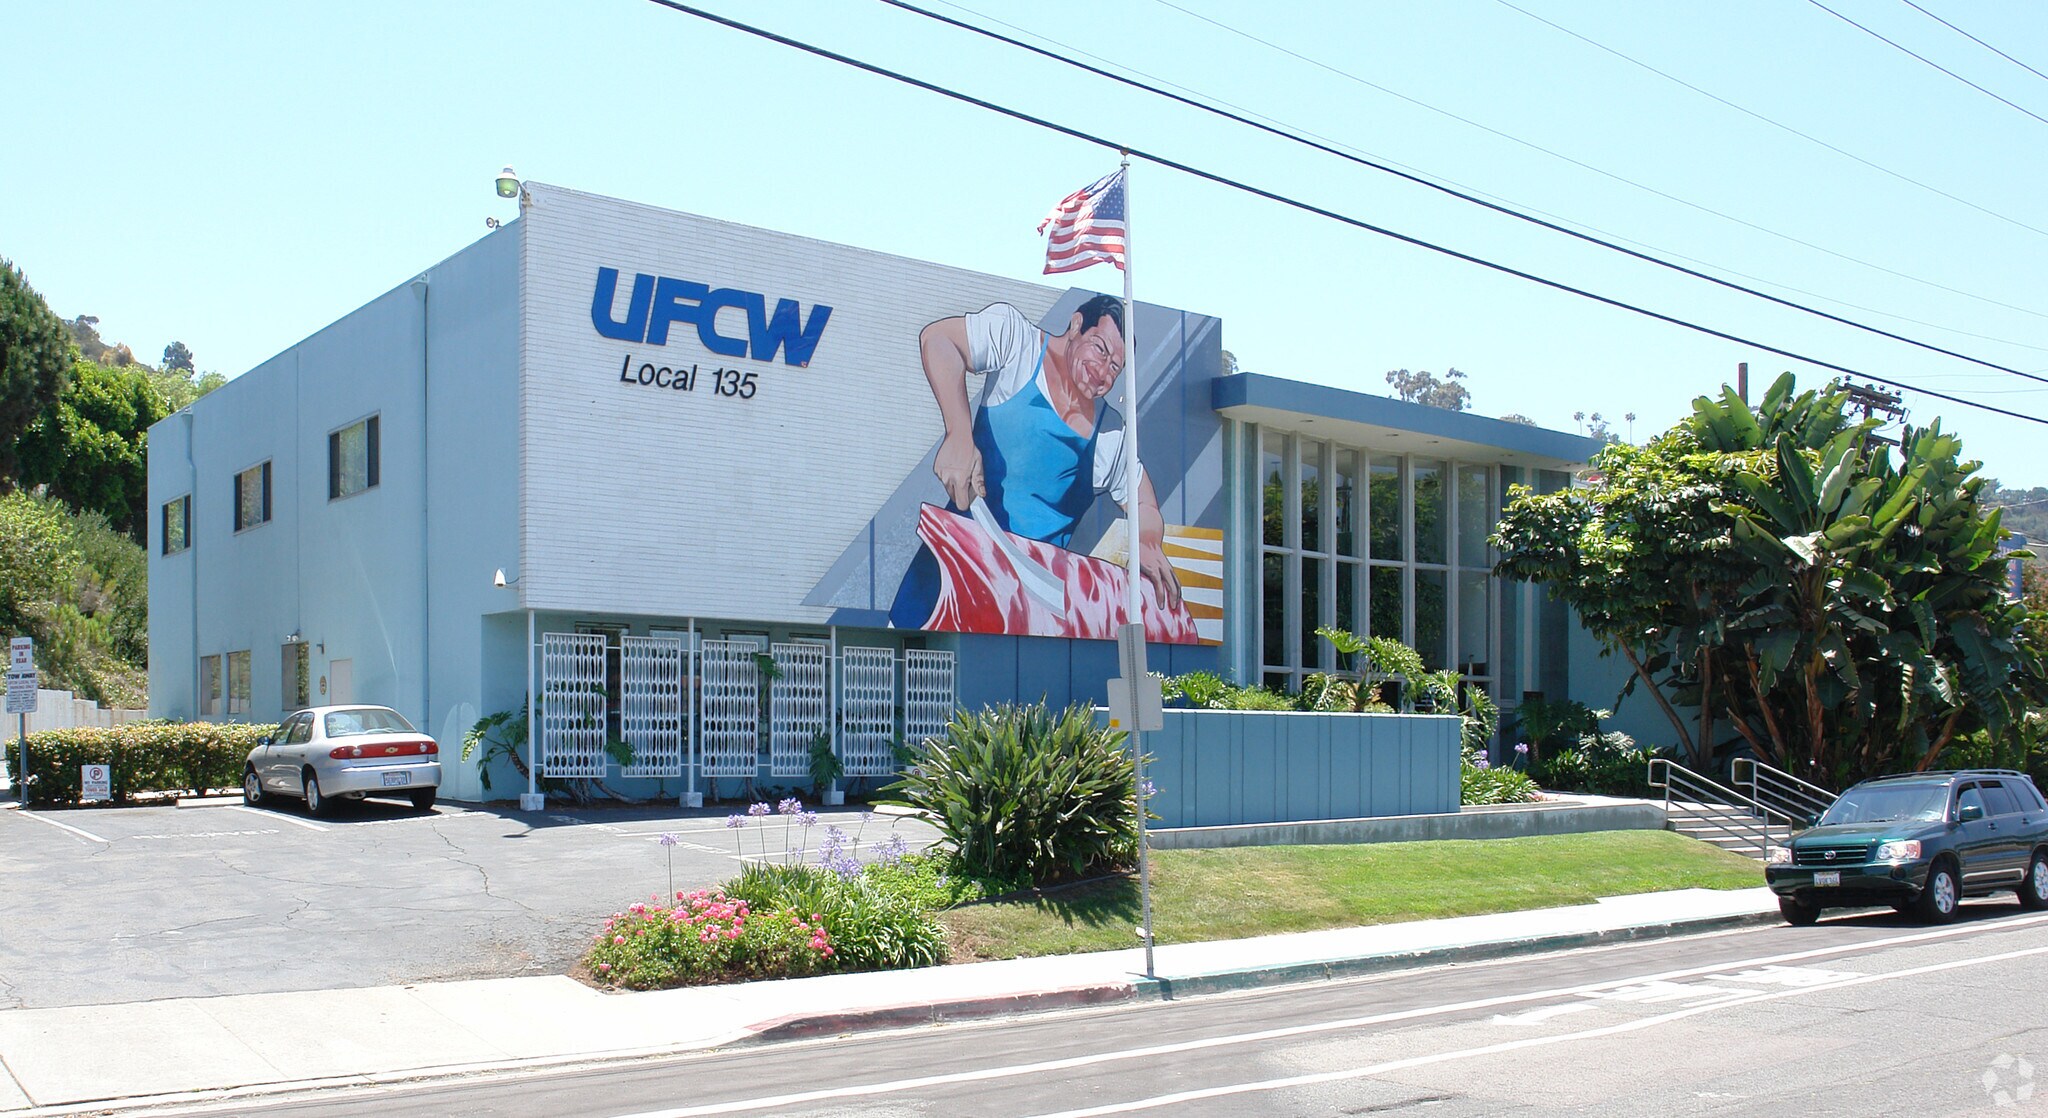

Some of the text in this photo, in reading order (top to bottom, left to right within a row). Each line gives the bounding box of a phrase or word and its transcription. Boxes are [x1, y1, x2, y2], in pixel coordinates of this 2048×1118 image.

[591, 266, 834, 368] UFCW
[620, 354, 759, 399] Local 135
